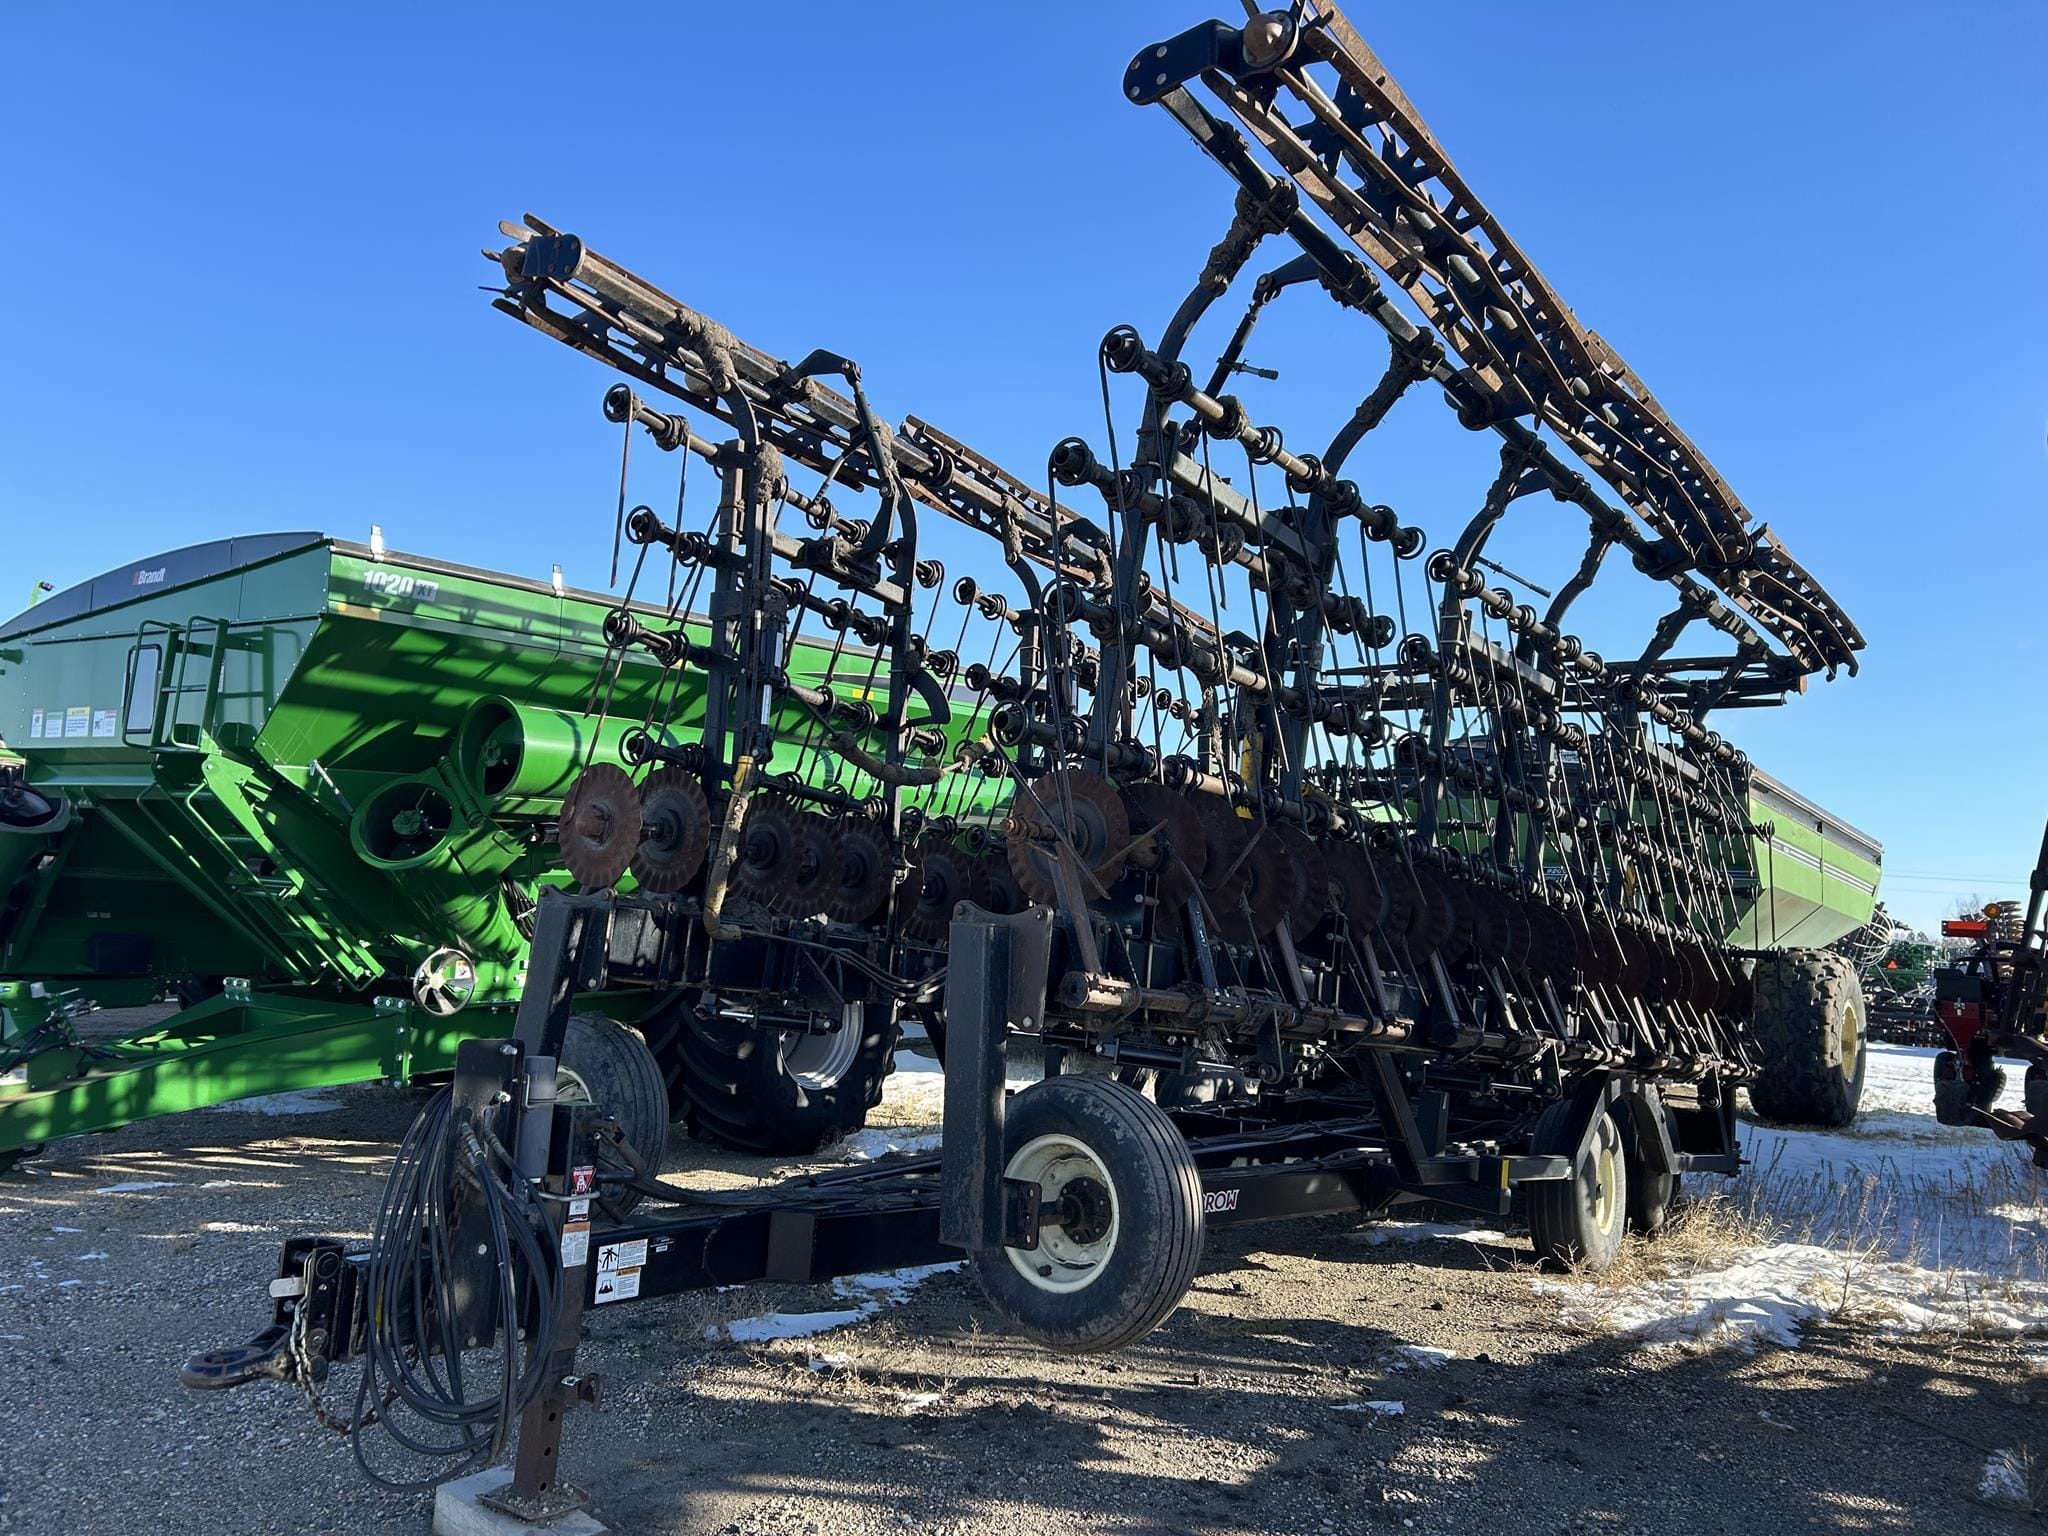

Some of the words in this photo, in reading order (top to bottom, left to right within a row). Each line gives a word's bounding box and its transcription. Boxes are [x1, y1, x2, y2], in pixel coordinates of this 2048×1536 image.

[138, 568, 166, 585] Brandt
[363, 569, 414, 597] 1020
[415, 581, 436, 599] XT
[1203, 1189, 1240, 1213] ROW
